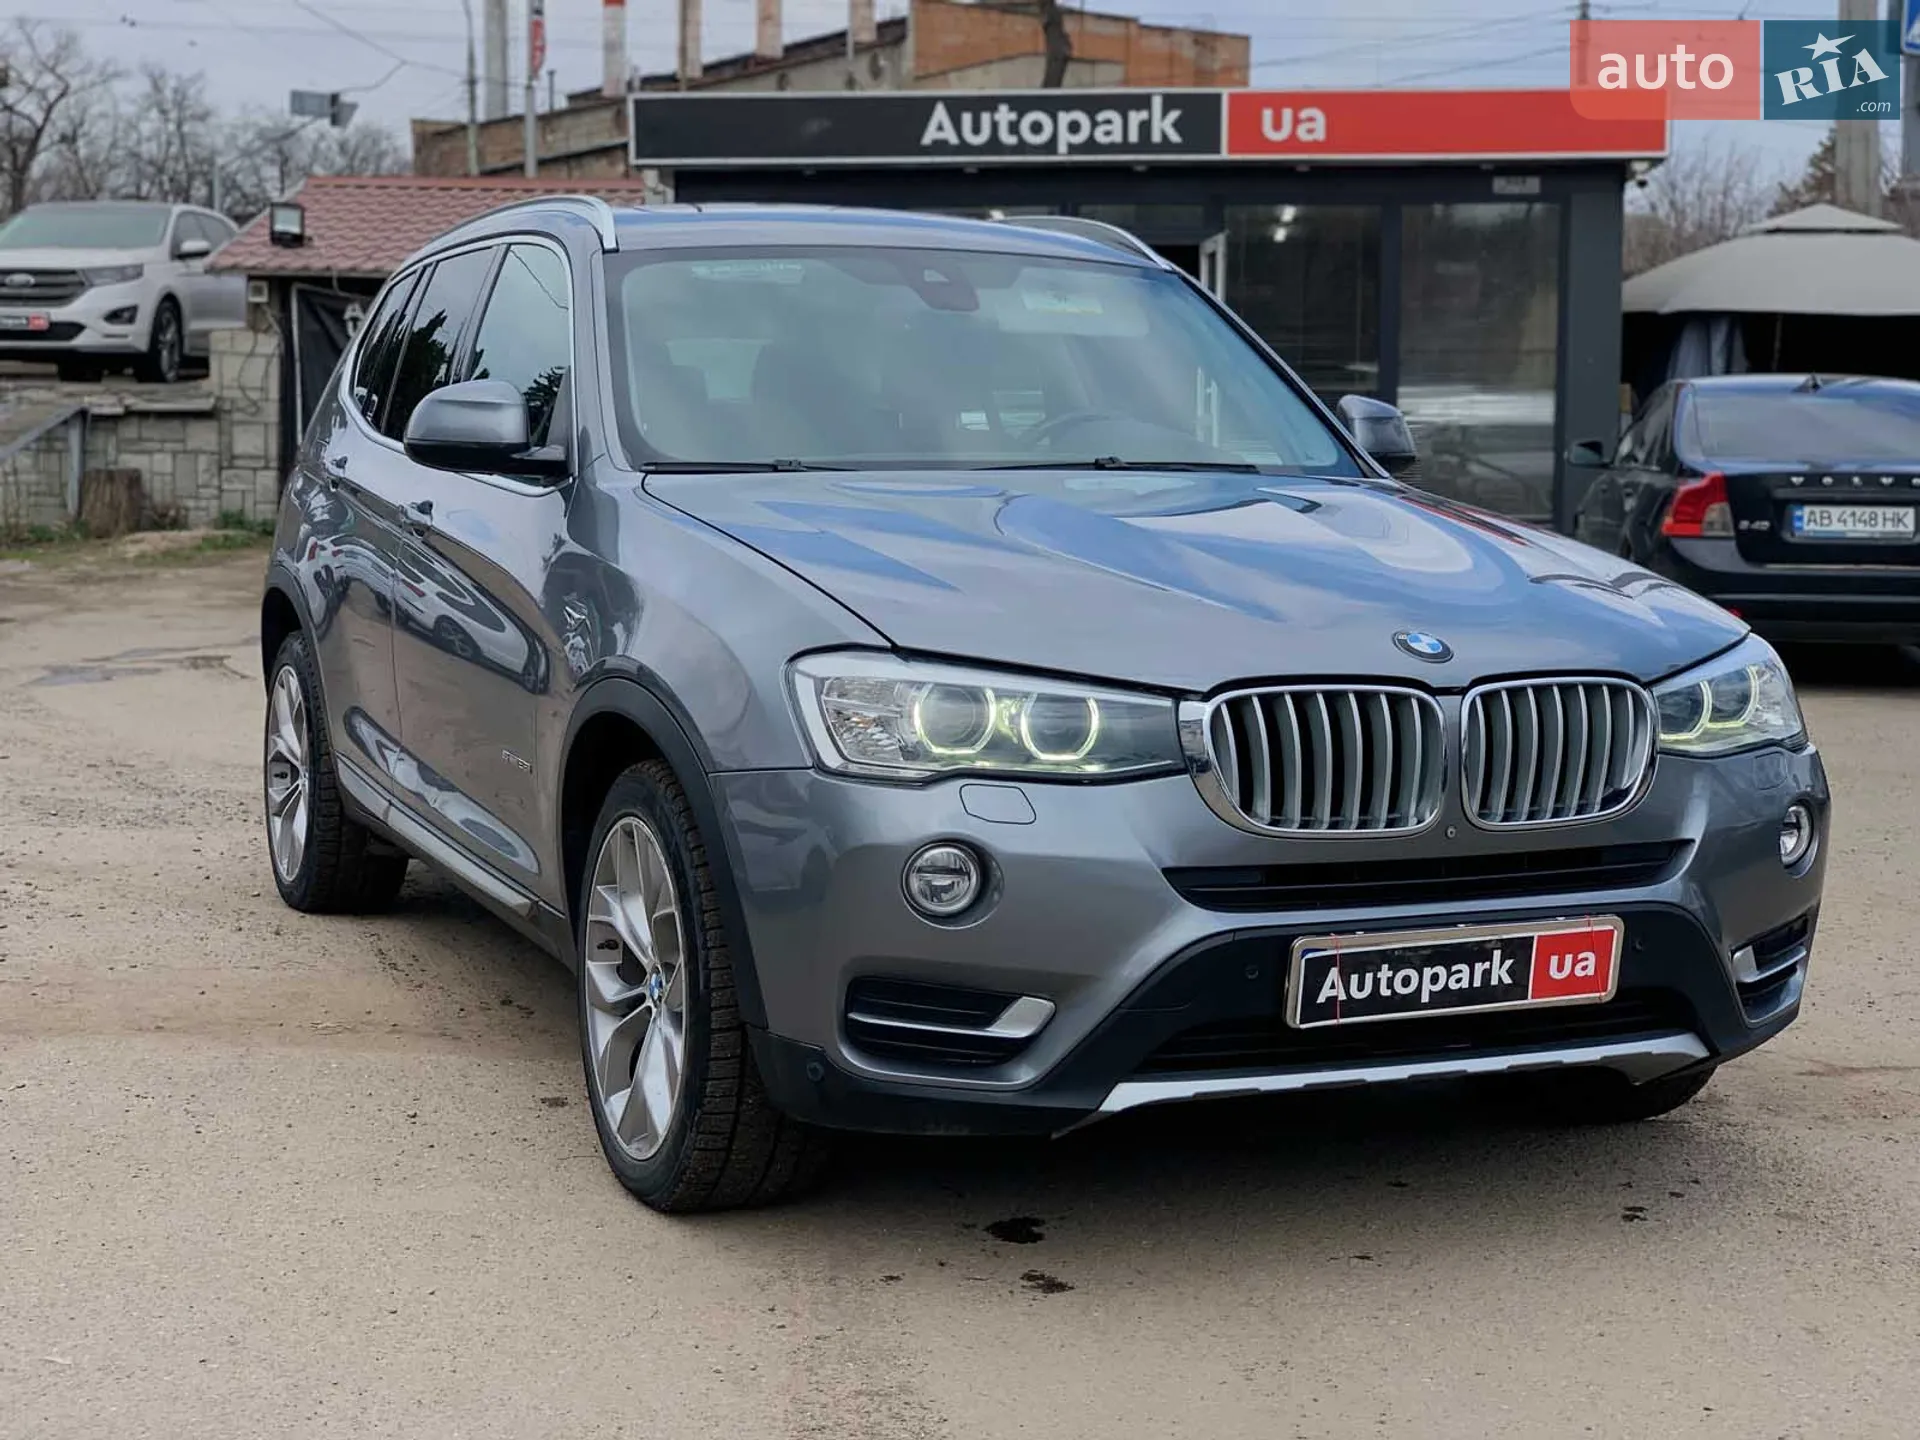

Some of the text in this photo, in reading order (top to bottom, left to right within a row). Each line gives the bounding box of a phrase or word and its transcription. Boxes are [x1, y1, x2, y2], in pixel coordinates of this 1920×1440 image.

[921, 95, 1326, 154] Autopark ua
[1805, 510, 1910, 529] AB 4148 HK
[1316, 949, 1596, 1004] Autopark ua
